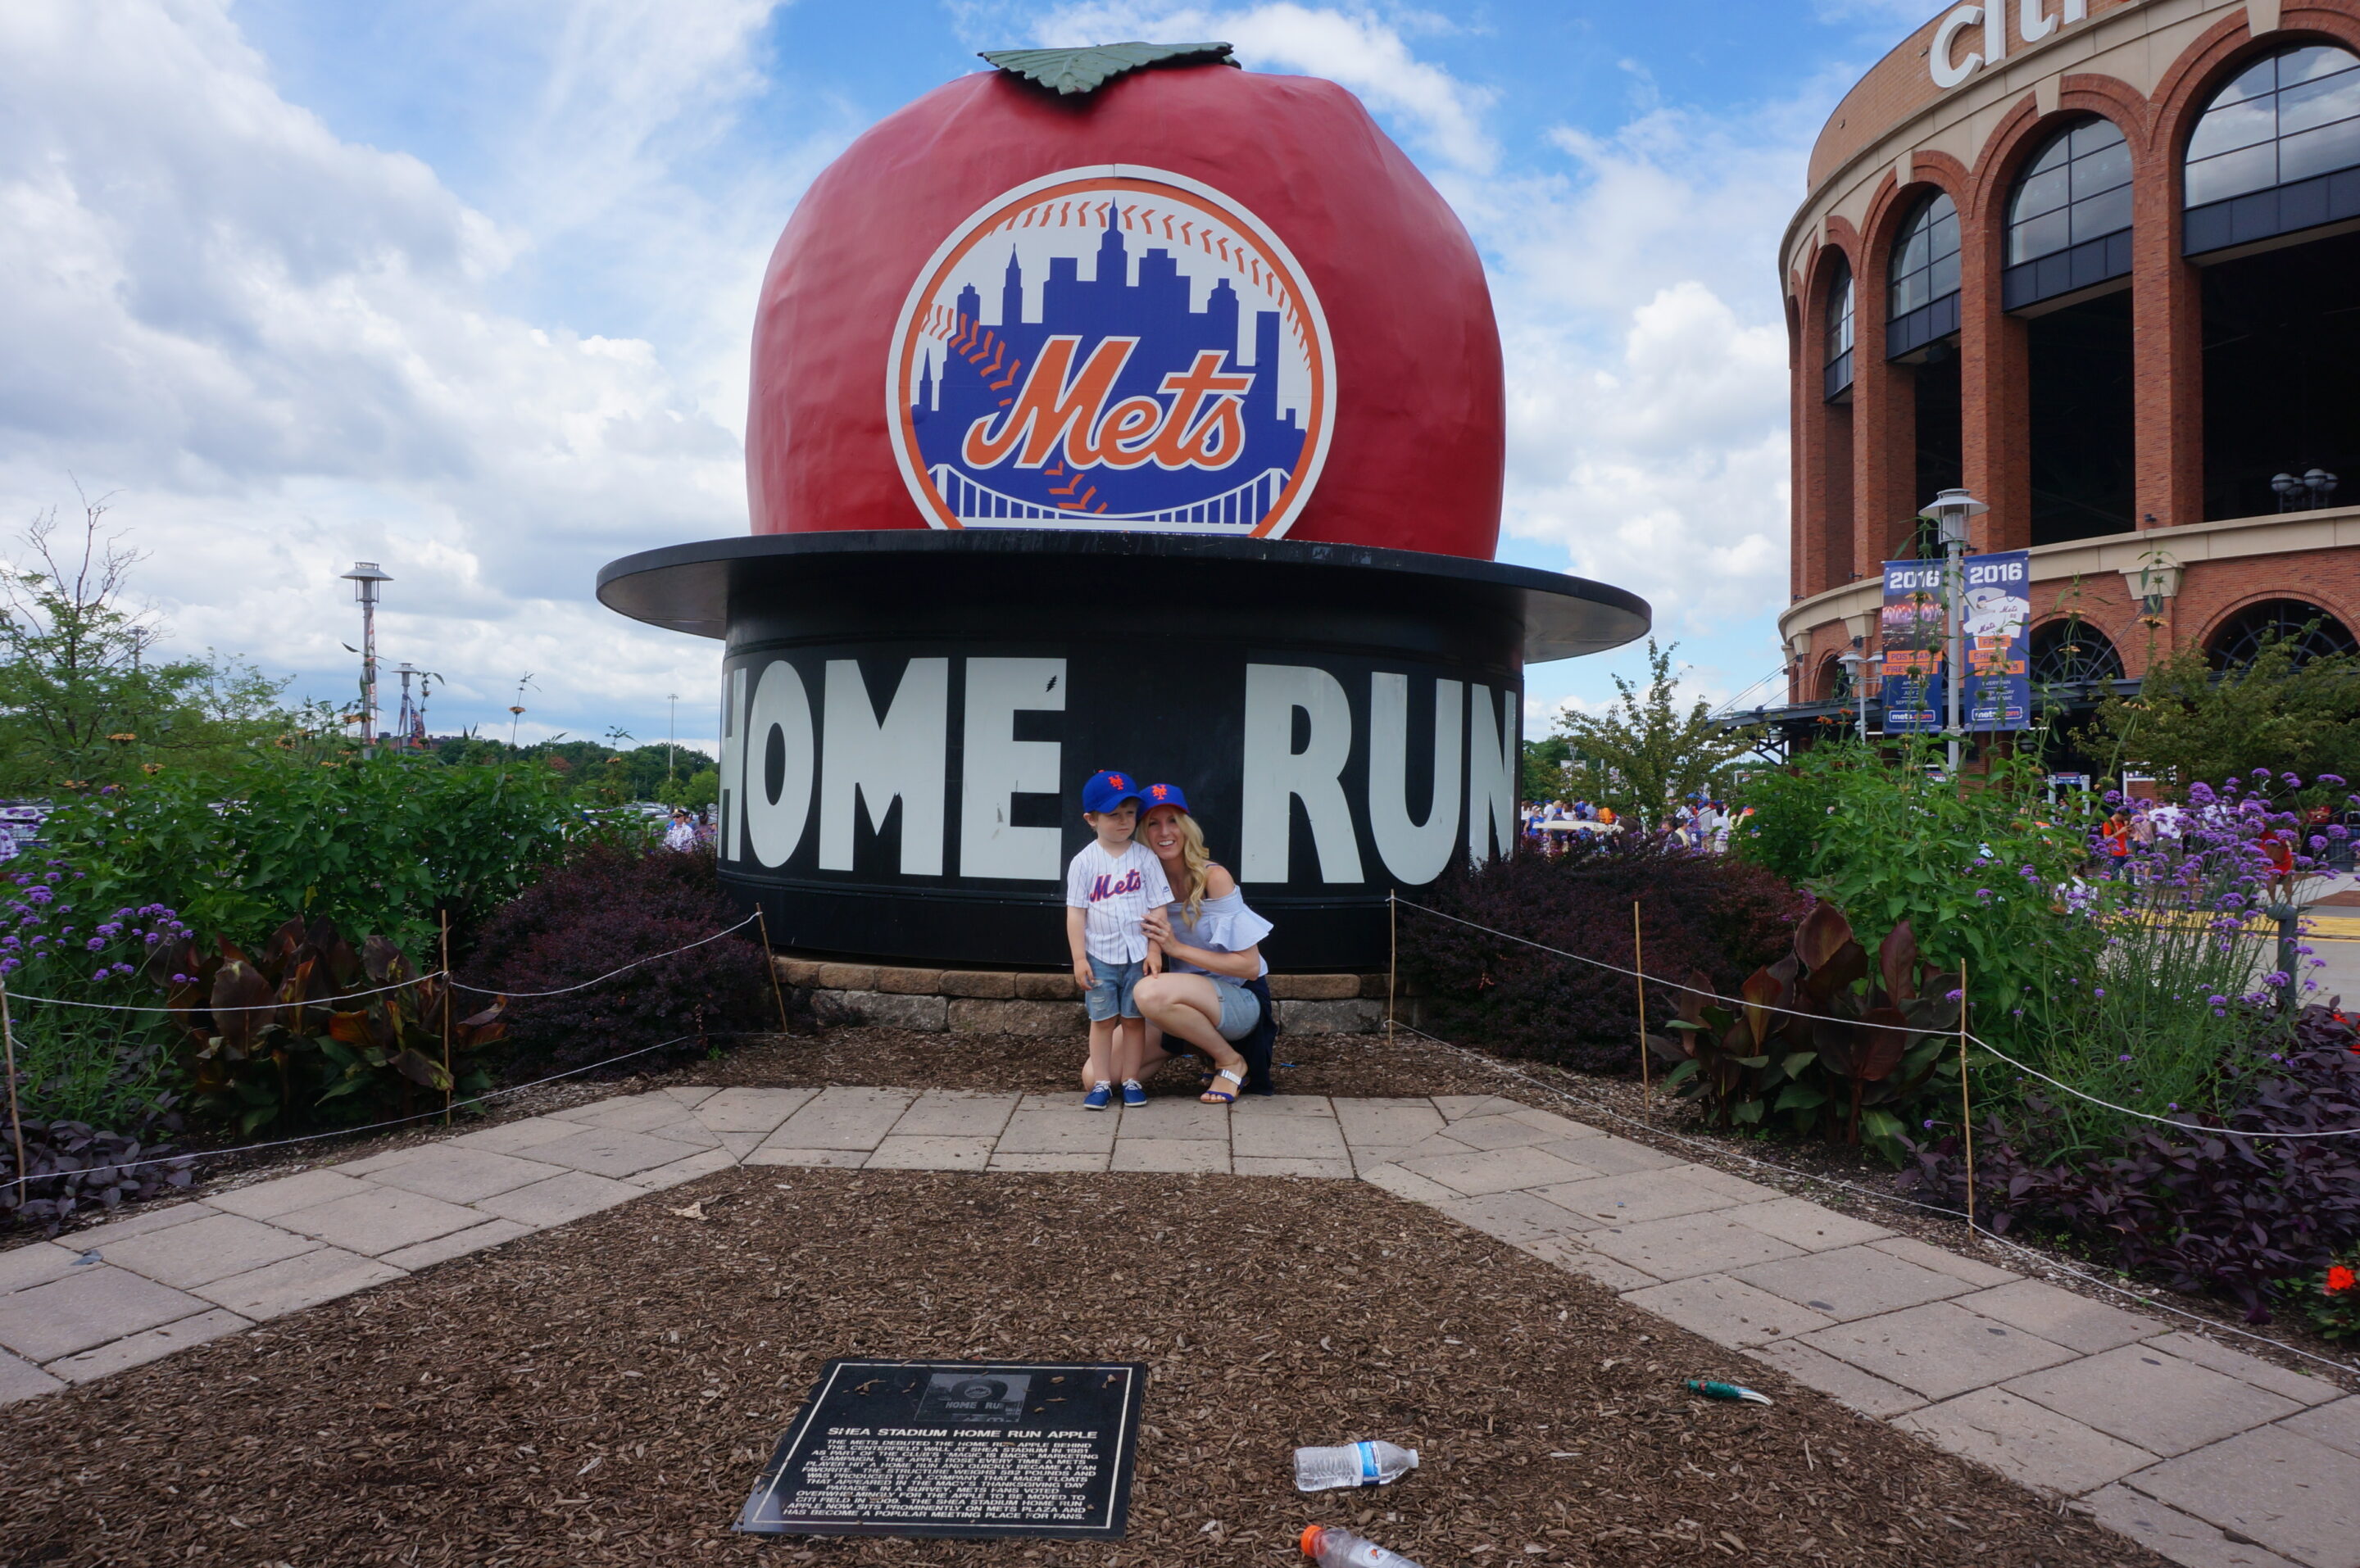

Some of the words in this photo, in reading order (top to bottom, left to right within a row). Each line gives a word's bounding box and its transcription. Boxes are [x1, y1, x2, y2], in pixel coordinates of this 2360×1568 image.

[962, 335, 1255, 470] Mets
[1970, 563, 2022, 584] 2016
[717, 658, 1068, 881] HOME
[1241, 663, 1517, 886] RUN
[1090, 868, 1141, 903] Mets
[878, 1429, 947, 1437] STADIUM
